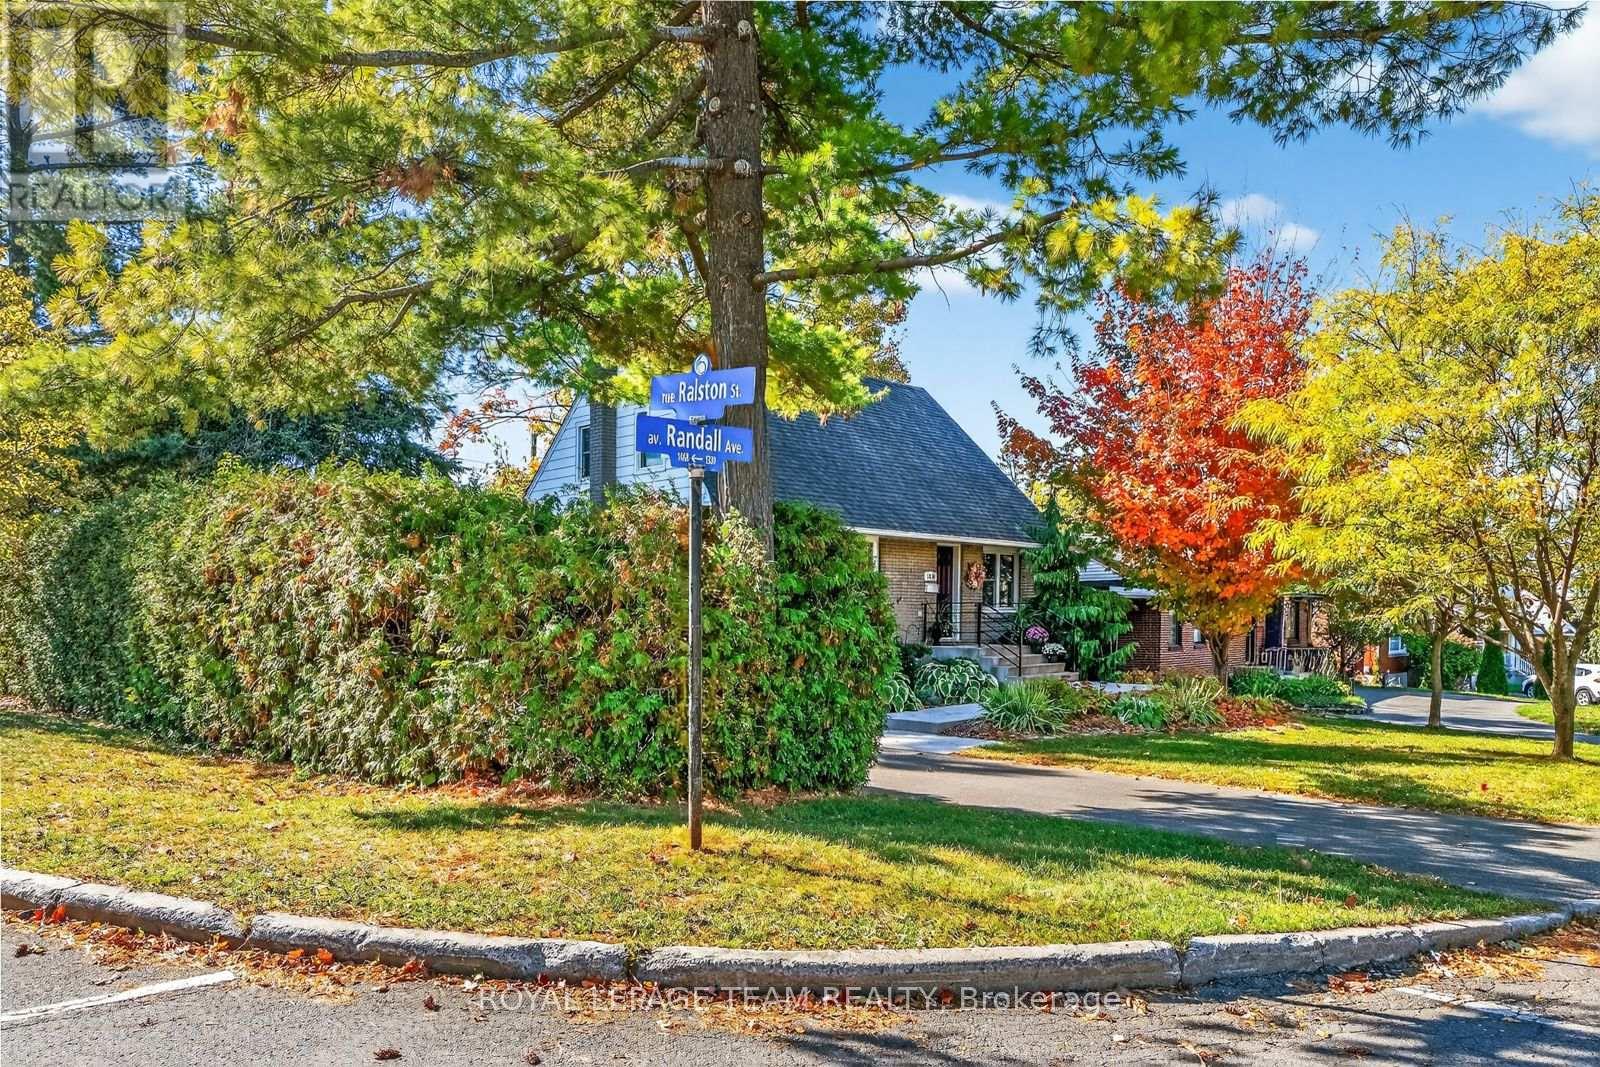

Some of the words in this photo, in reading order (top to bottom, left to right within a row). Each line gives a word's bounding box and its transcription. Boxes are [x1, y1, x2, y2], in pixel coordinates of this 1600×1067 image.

[661, 392, 676, 404] rue
[679, 378, 727, 402] Ralston
[647, 433, 662, 445] av.
[666, 424, 722, 452] Randall
